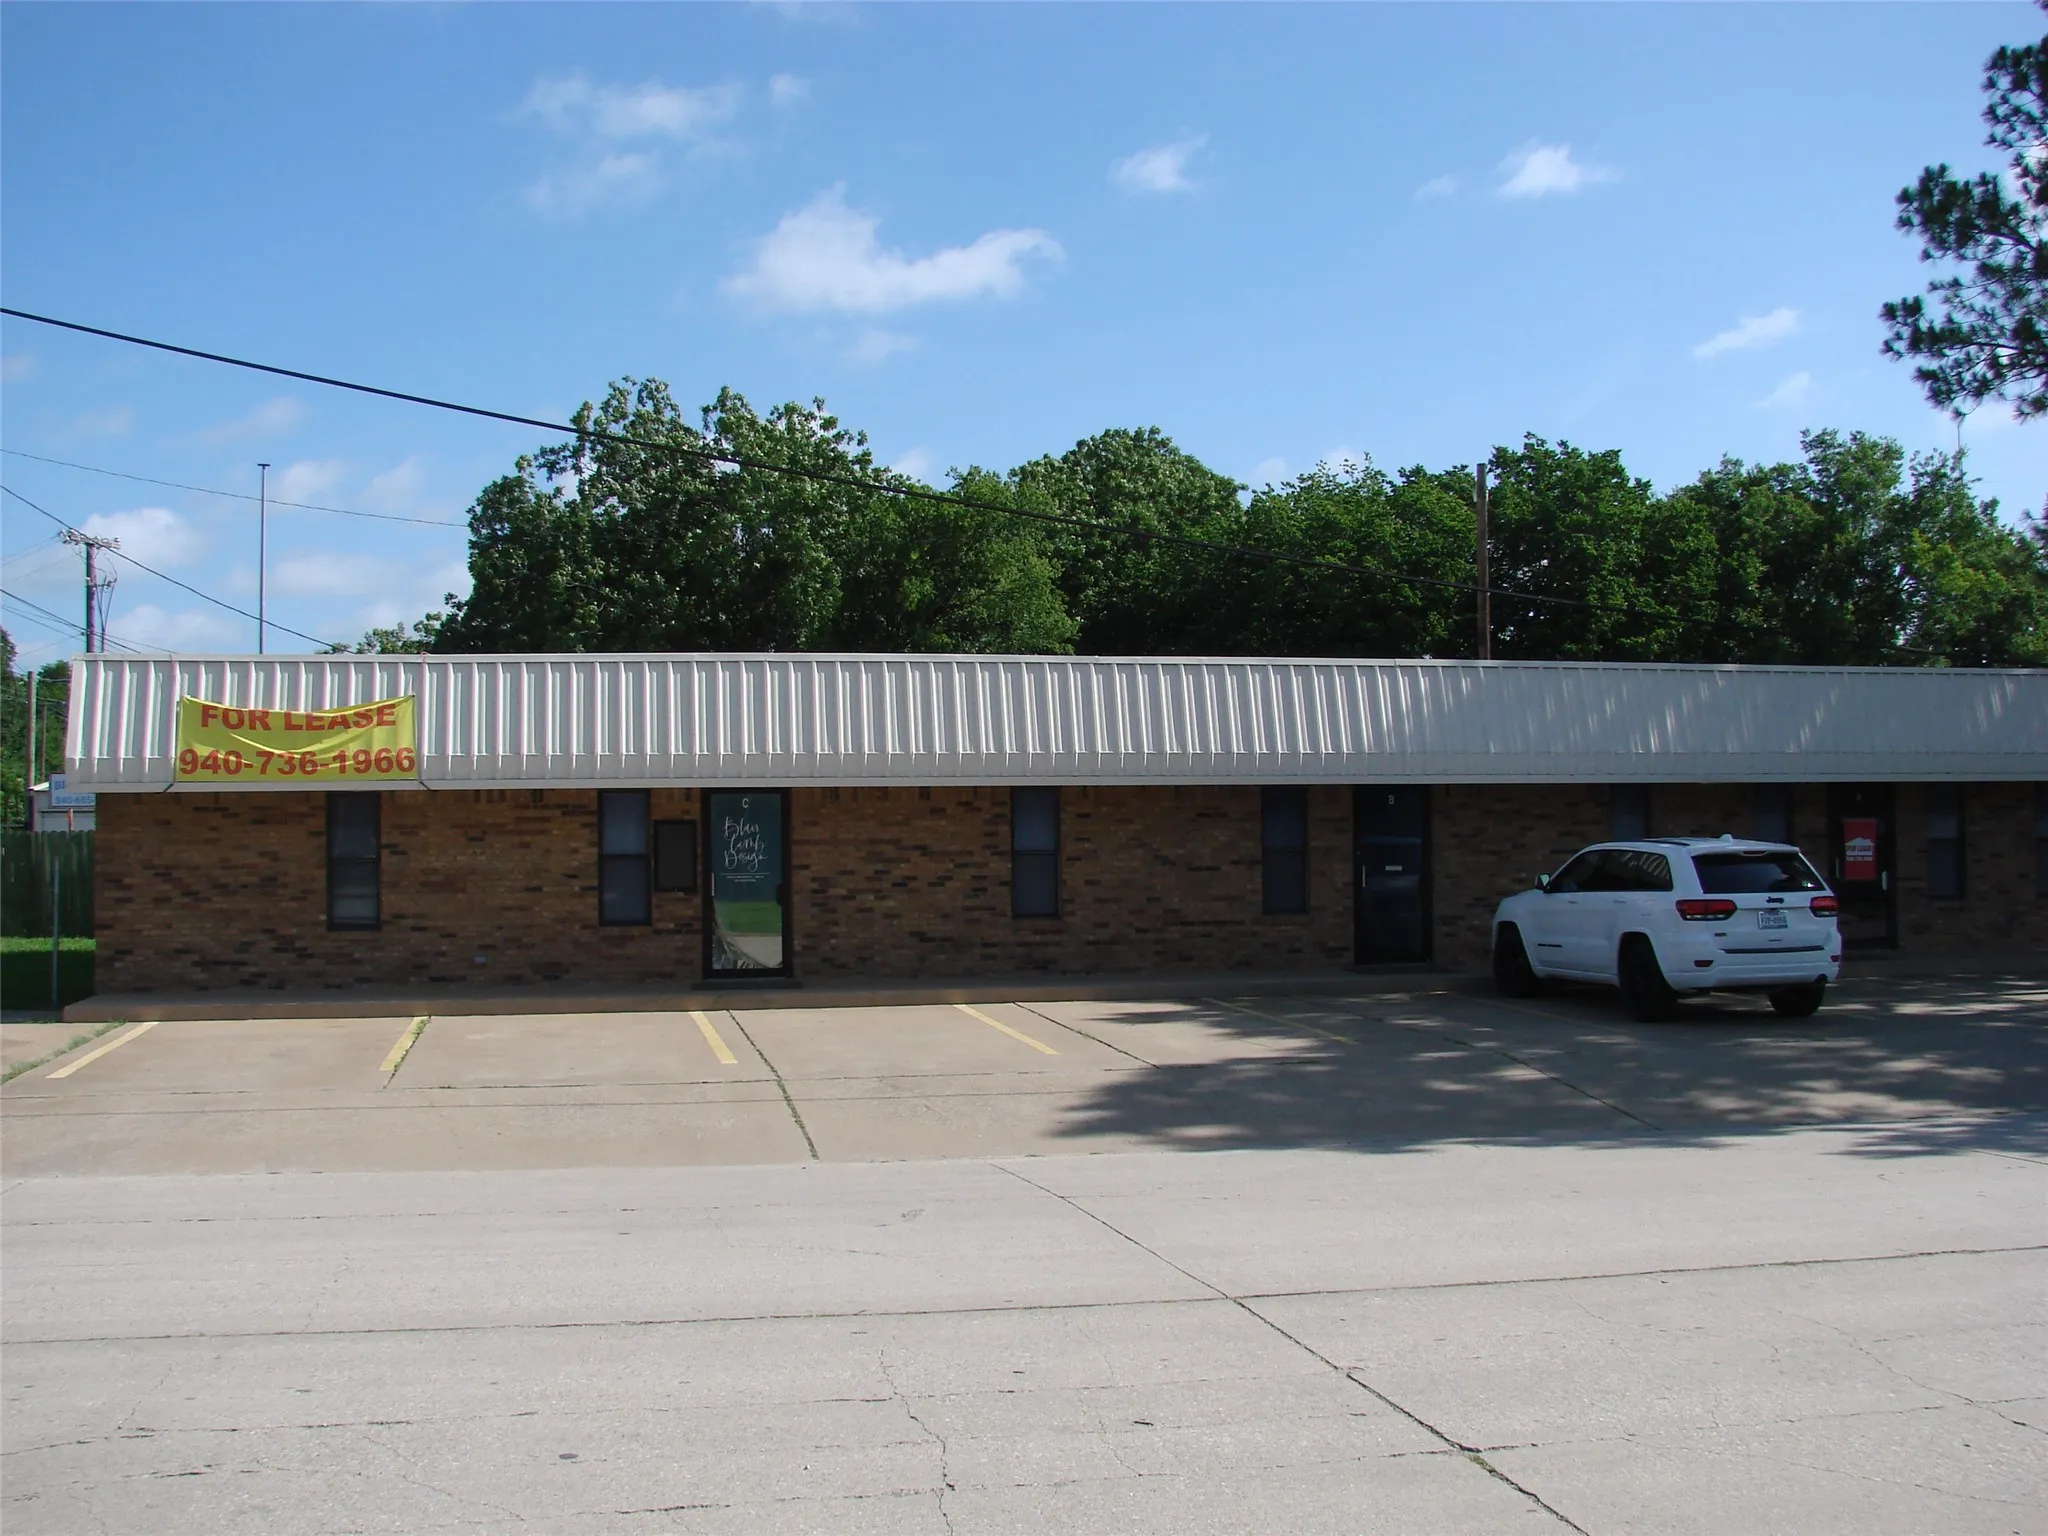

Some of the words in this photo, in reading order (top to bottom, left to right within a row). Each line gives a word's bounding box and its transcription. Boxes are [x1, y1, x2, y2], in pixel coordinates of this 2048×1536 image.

[200, 704, 272, 731] FOR
[284, 703, 397, 731] LEASE
[179, 747, 416, 775] 940-736-1966
[742, 798, 749, 808] C
[1766, 896, 1785, 904] Jeep
